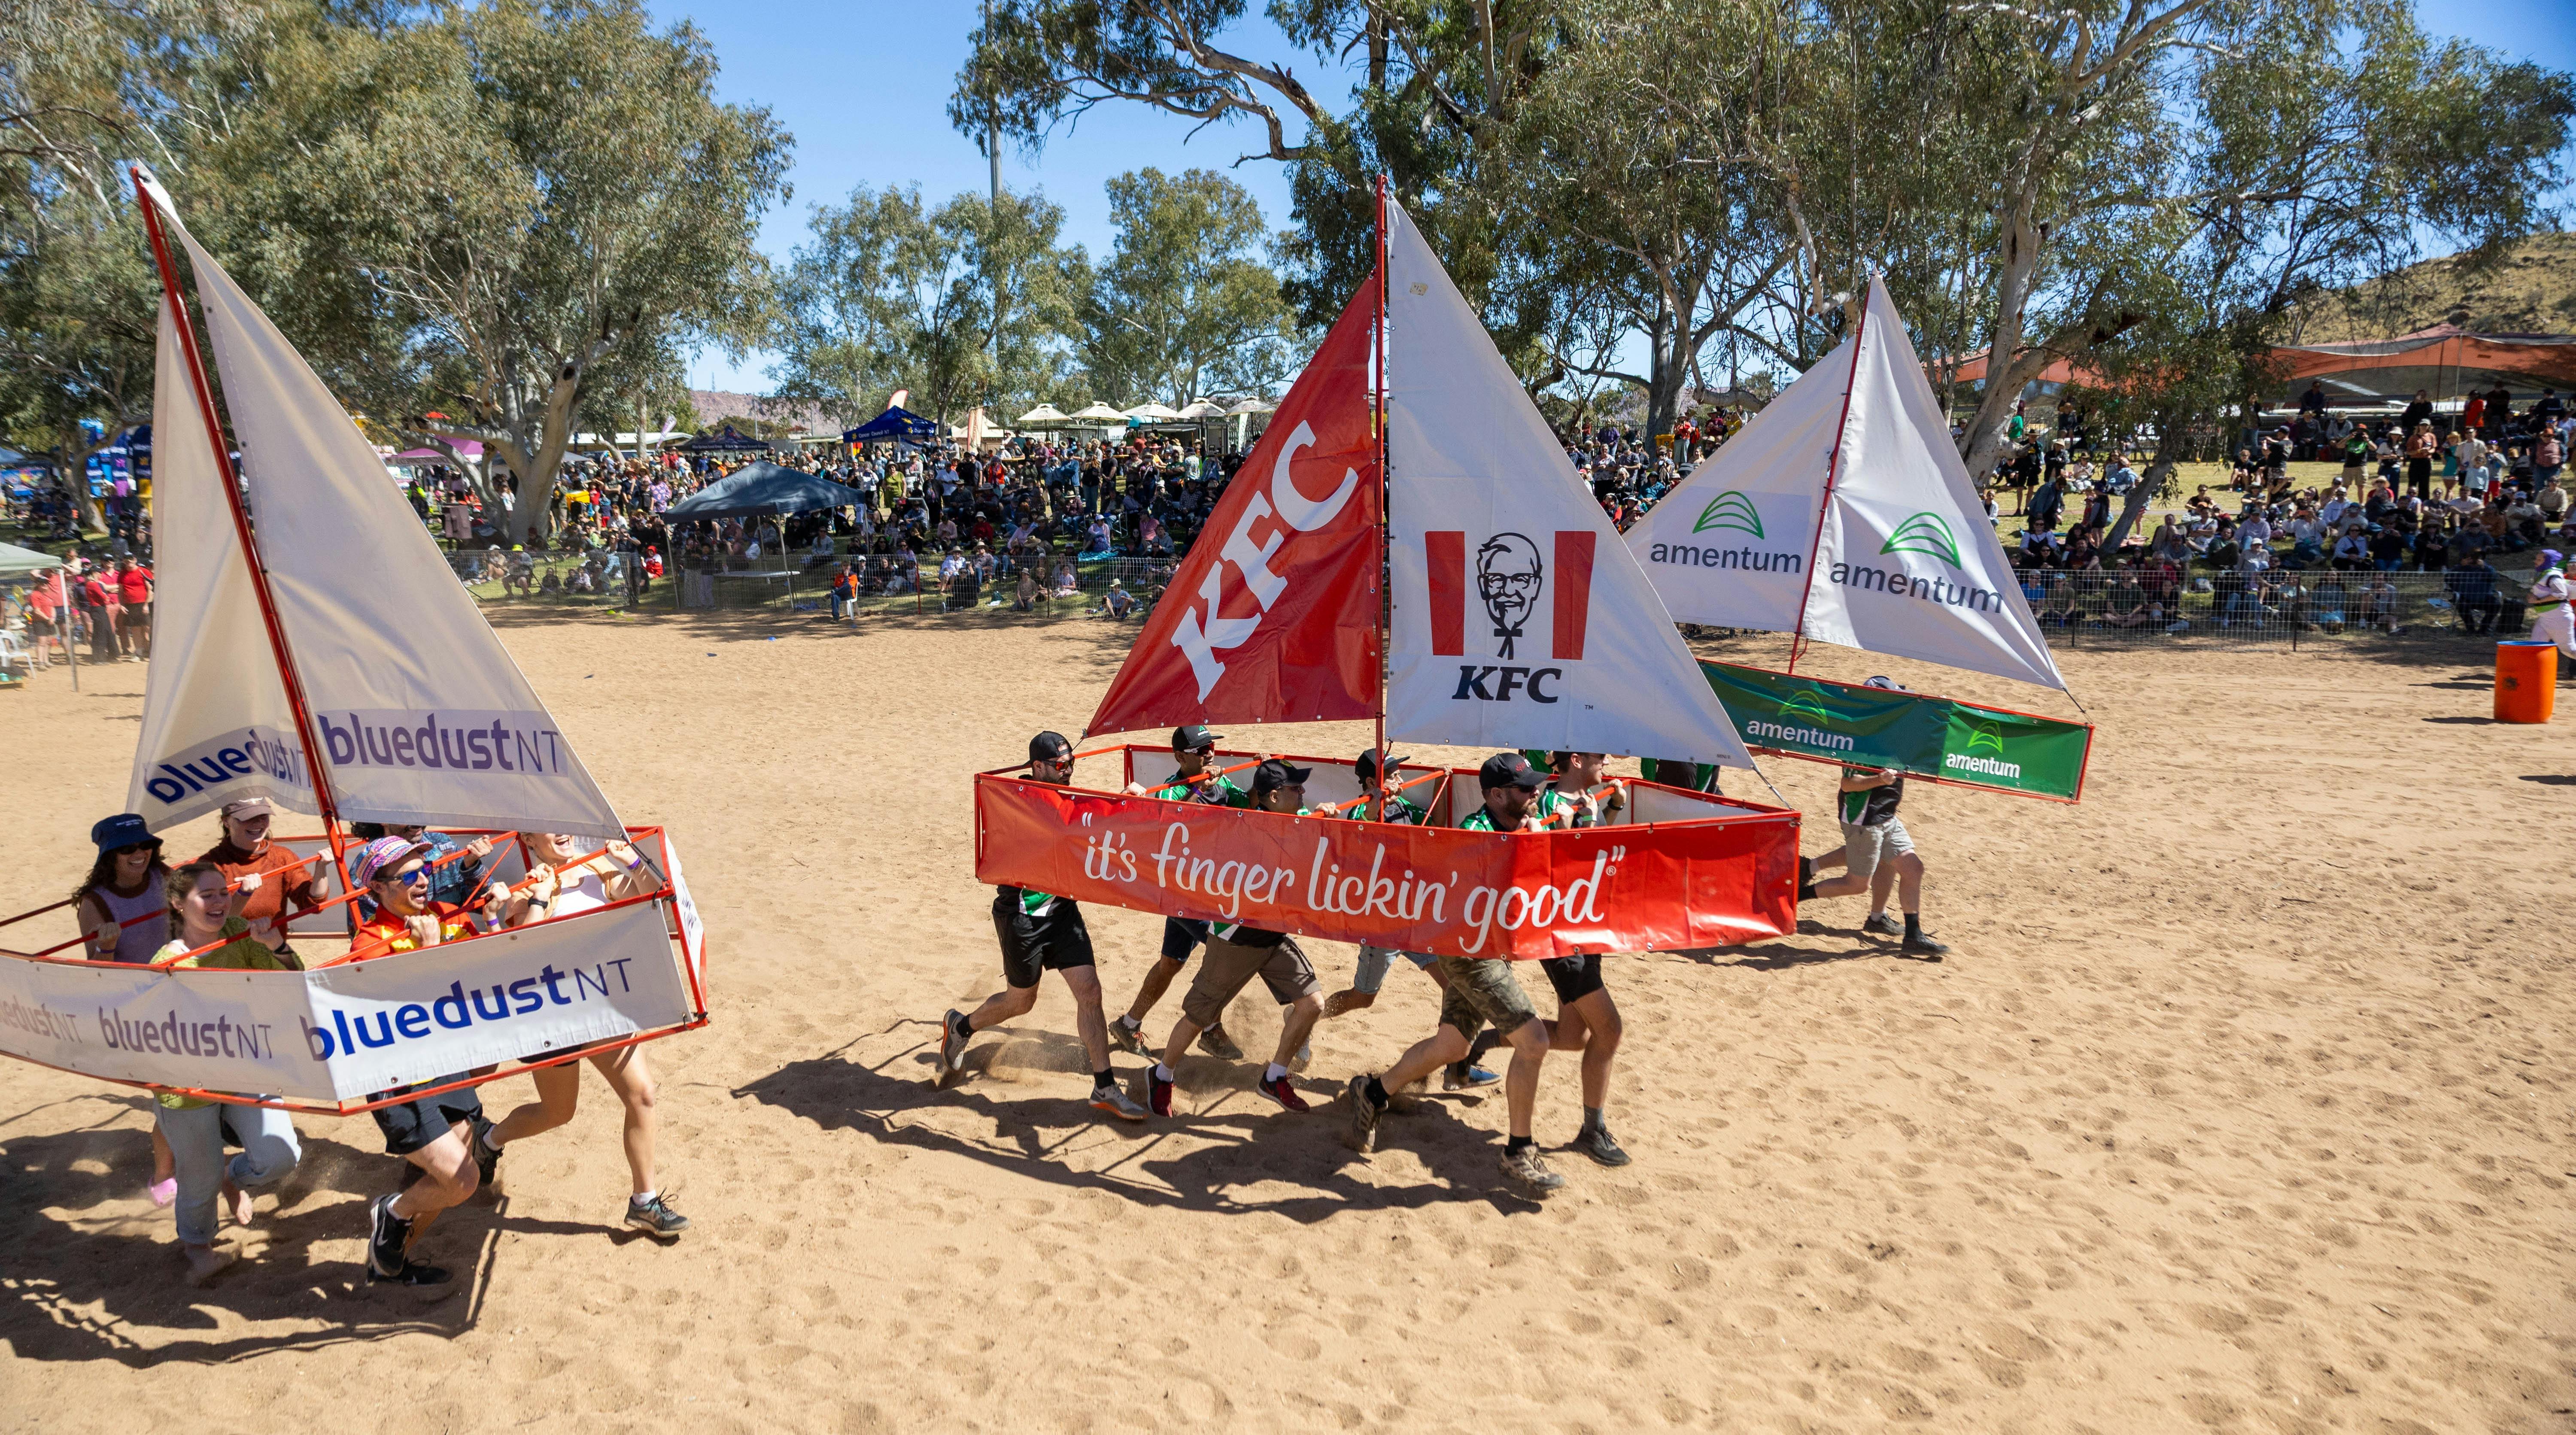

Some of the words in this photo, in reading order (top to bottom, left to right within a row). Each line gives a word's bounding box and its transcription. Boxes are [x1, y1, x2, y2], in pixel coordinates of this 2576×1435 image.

[1171, 419, 1358, 704] KFC
[1650, 543, 1801, 573] amentum
[1830, 560, 2003, 614] amentum
[1452, 665, 1561, 703] KFC
[1747, 720, 1854, 751] amentum
[1947, 753, 2020, 779] amentum
[1151, 822, 1296, 919] finger
[1307, 836, 1457, 924] lickin'
